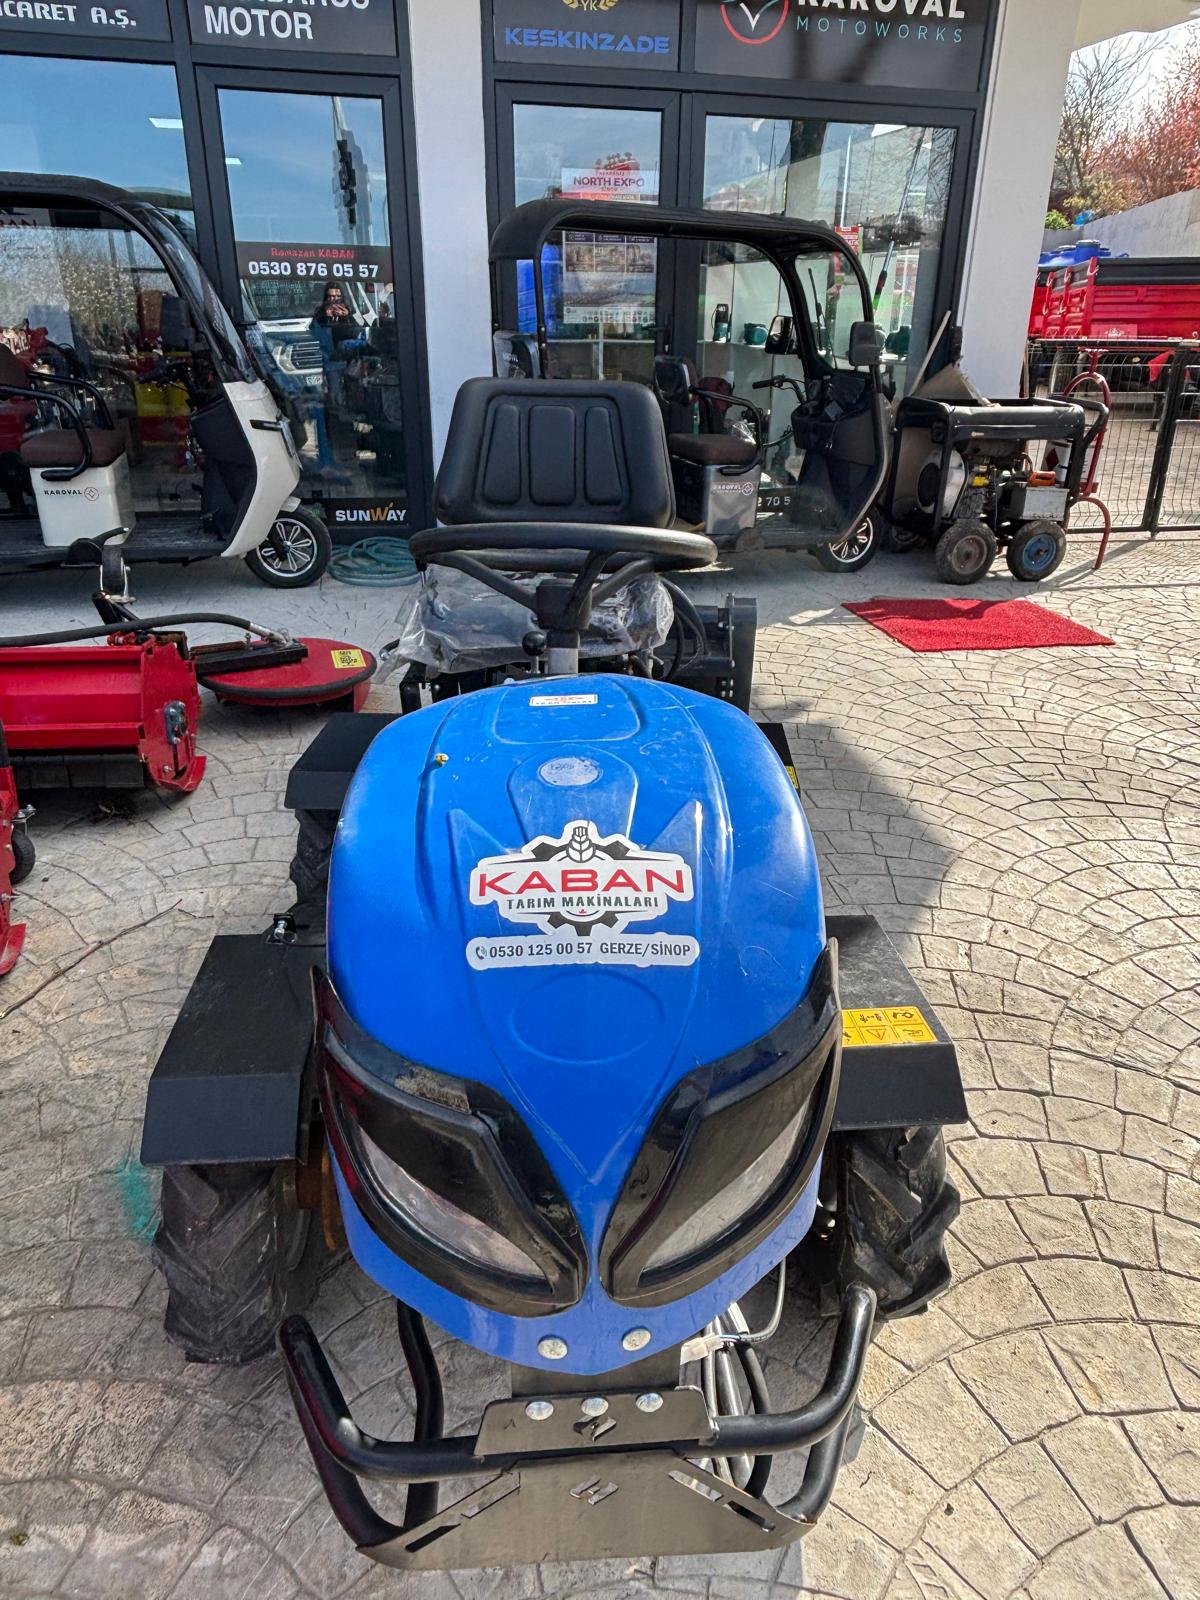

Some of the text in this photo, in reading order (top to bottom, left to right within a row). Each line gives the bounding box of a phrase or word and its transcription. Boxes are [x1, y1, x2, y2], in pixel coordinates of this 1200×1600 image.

[90, 7, 137, 28] A.Ş.
[204, 5, 314, 40] MOTOR
[796, 16, 962, 43] MOTOWORKS
[505, 27, 670, 54] KESKINZADE
[573, 176, 645, 188] NORTH EXPO
[271, 248, 355, 259] Ramazan KABAN
[249, 261, 379, 278] 0530 876 05 57
[766, 497, 780, 506] 70
[335, 502, 407, 522] SUNWAY
[478, 868, 685, 897] KABAN
[507, 893, 659, 909] TARIM MAKİNALARI
[489, 941, 691, 958] 0530 125 00 57 GERZE/SİNOP
